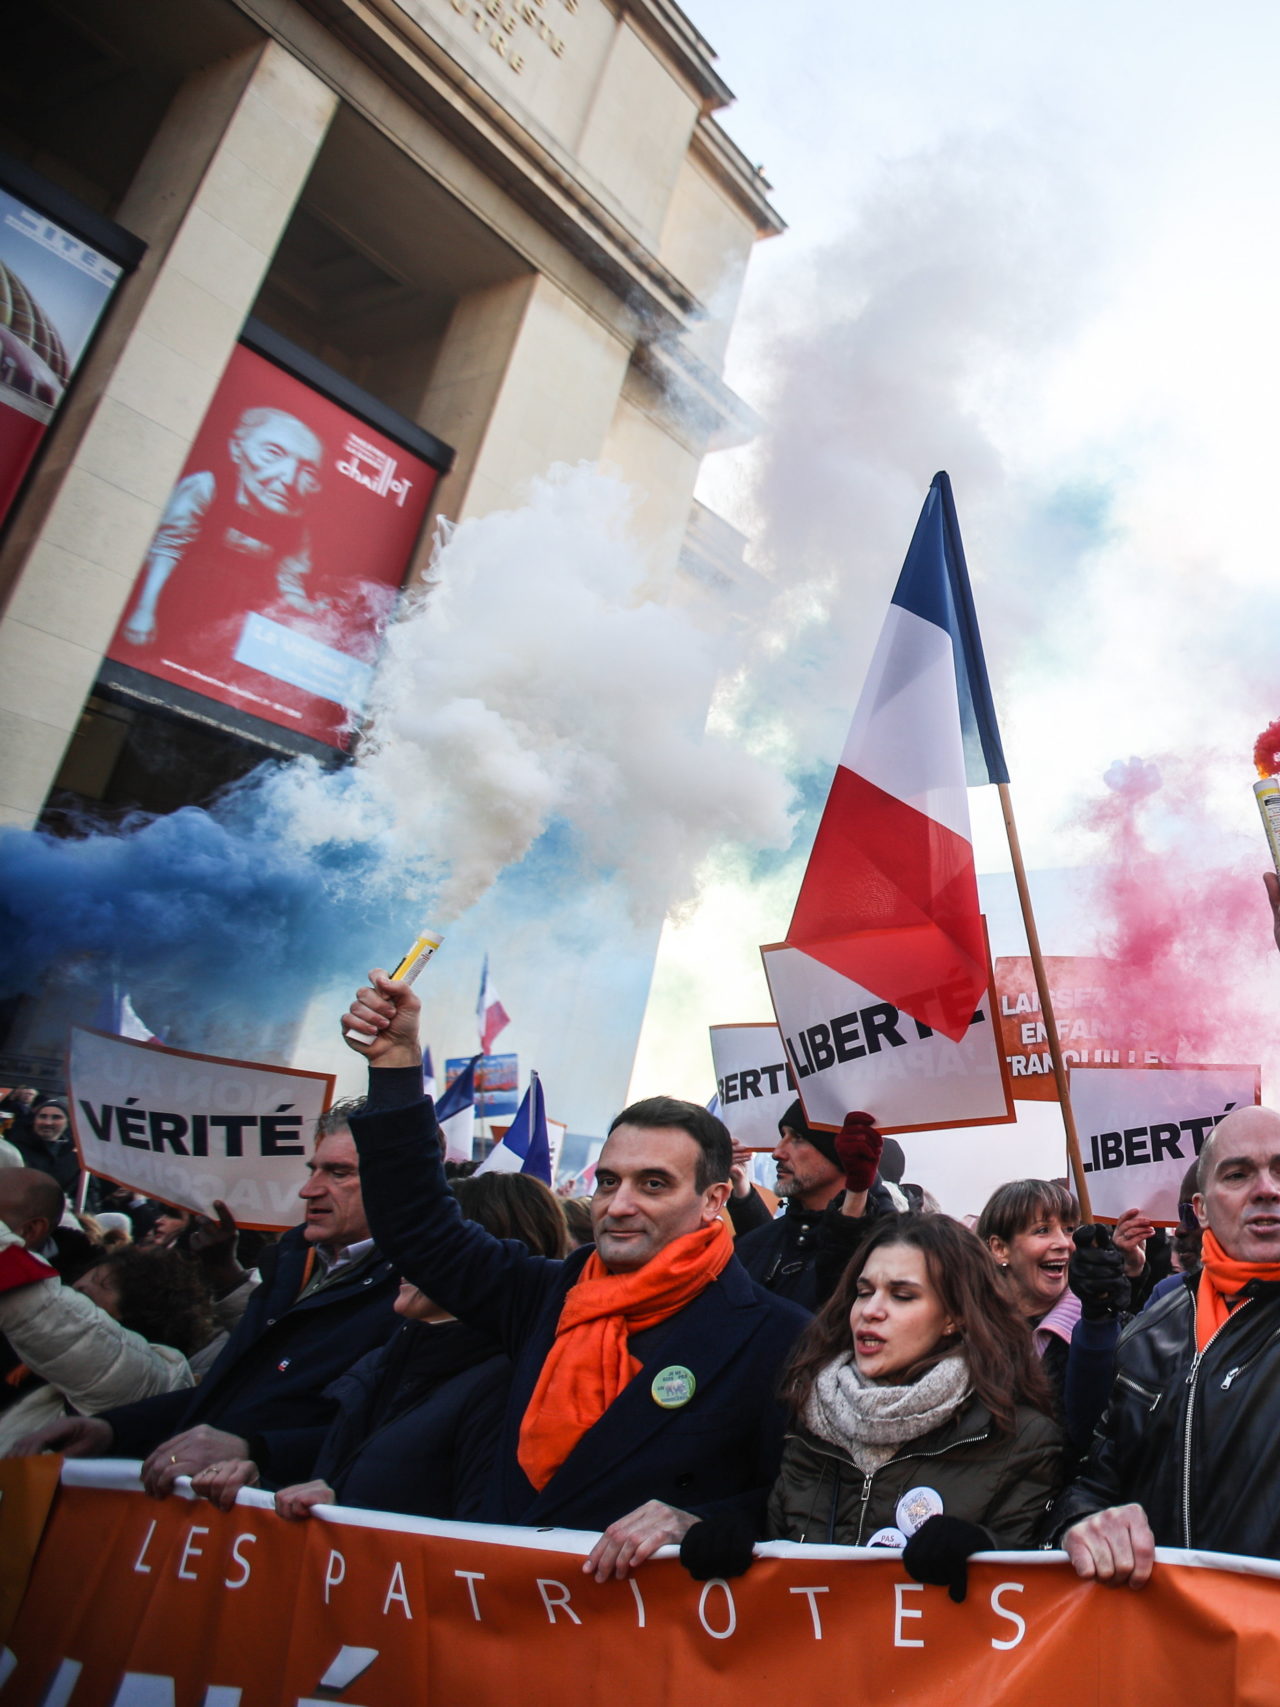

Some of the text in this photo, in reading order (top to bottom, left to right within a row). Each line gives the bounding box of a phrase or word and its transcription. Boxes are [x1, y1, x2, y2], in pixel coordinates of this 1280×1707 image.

[785, 966, 985, 1079] LIBERTÉ
[79, 1097, 305, 1157] VÉRITÉ
[134, 1519, 1026, 1650] LES PATRIOTES
